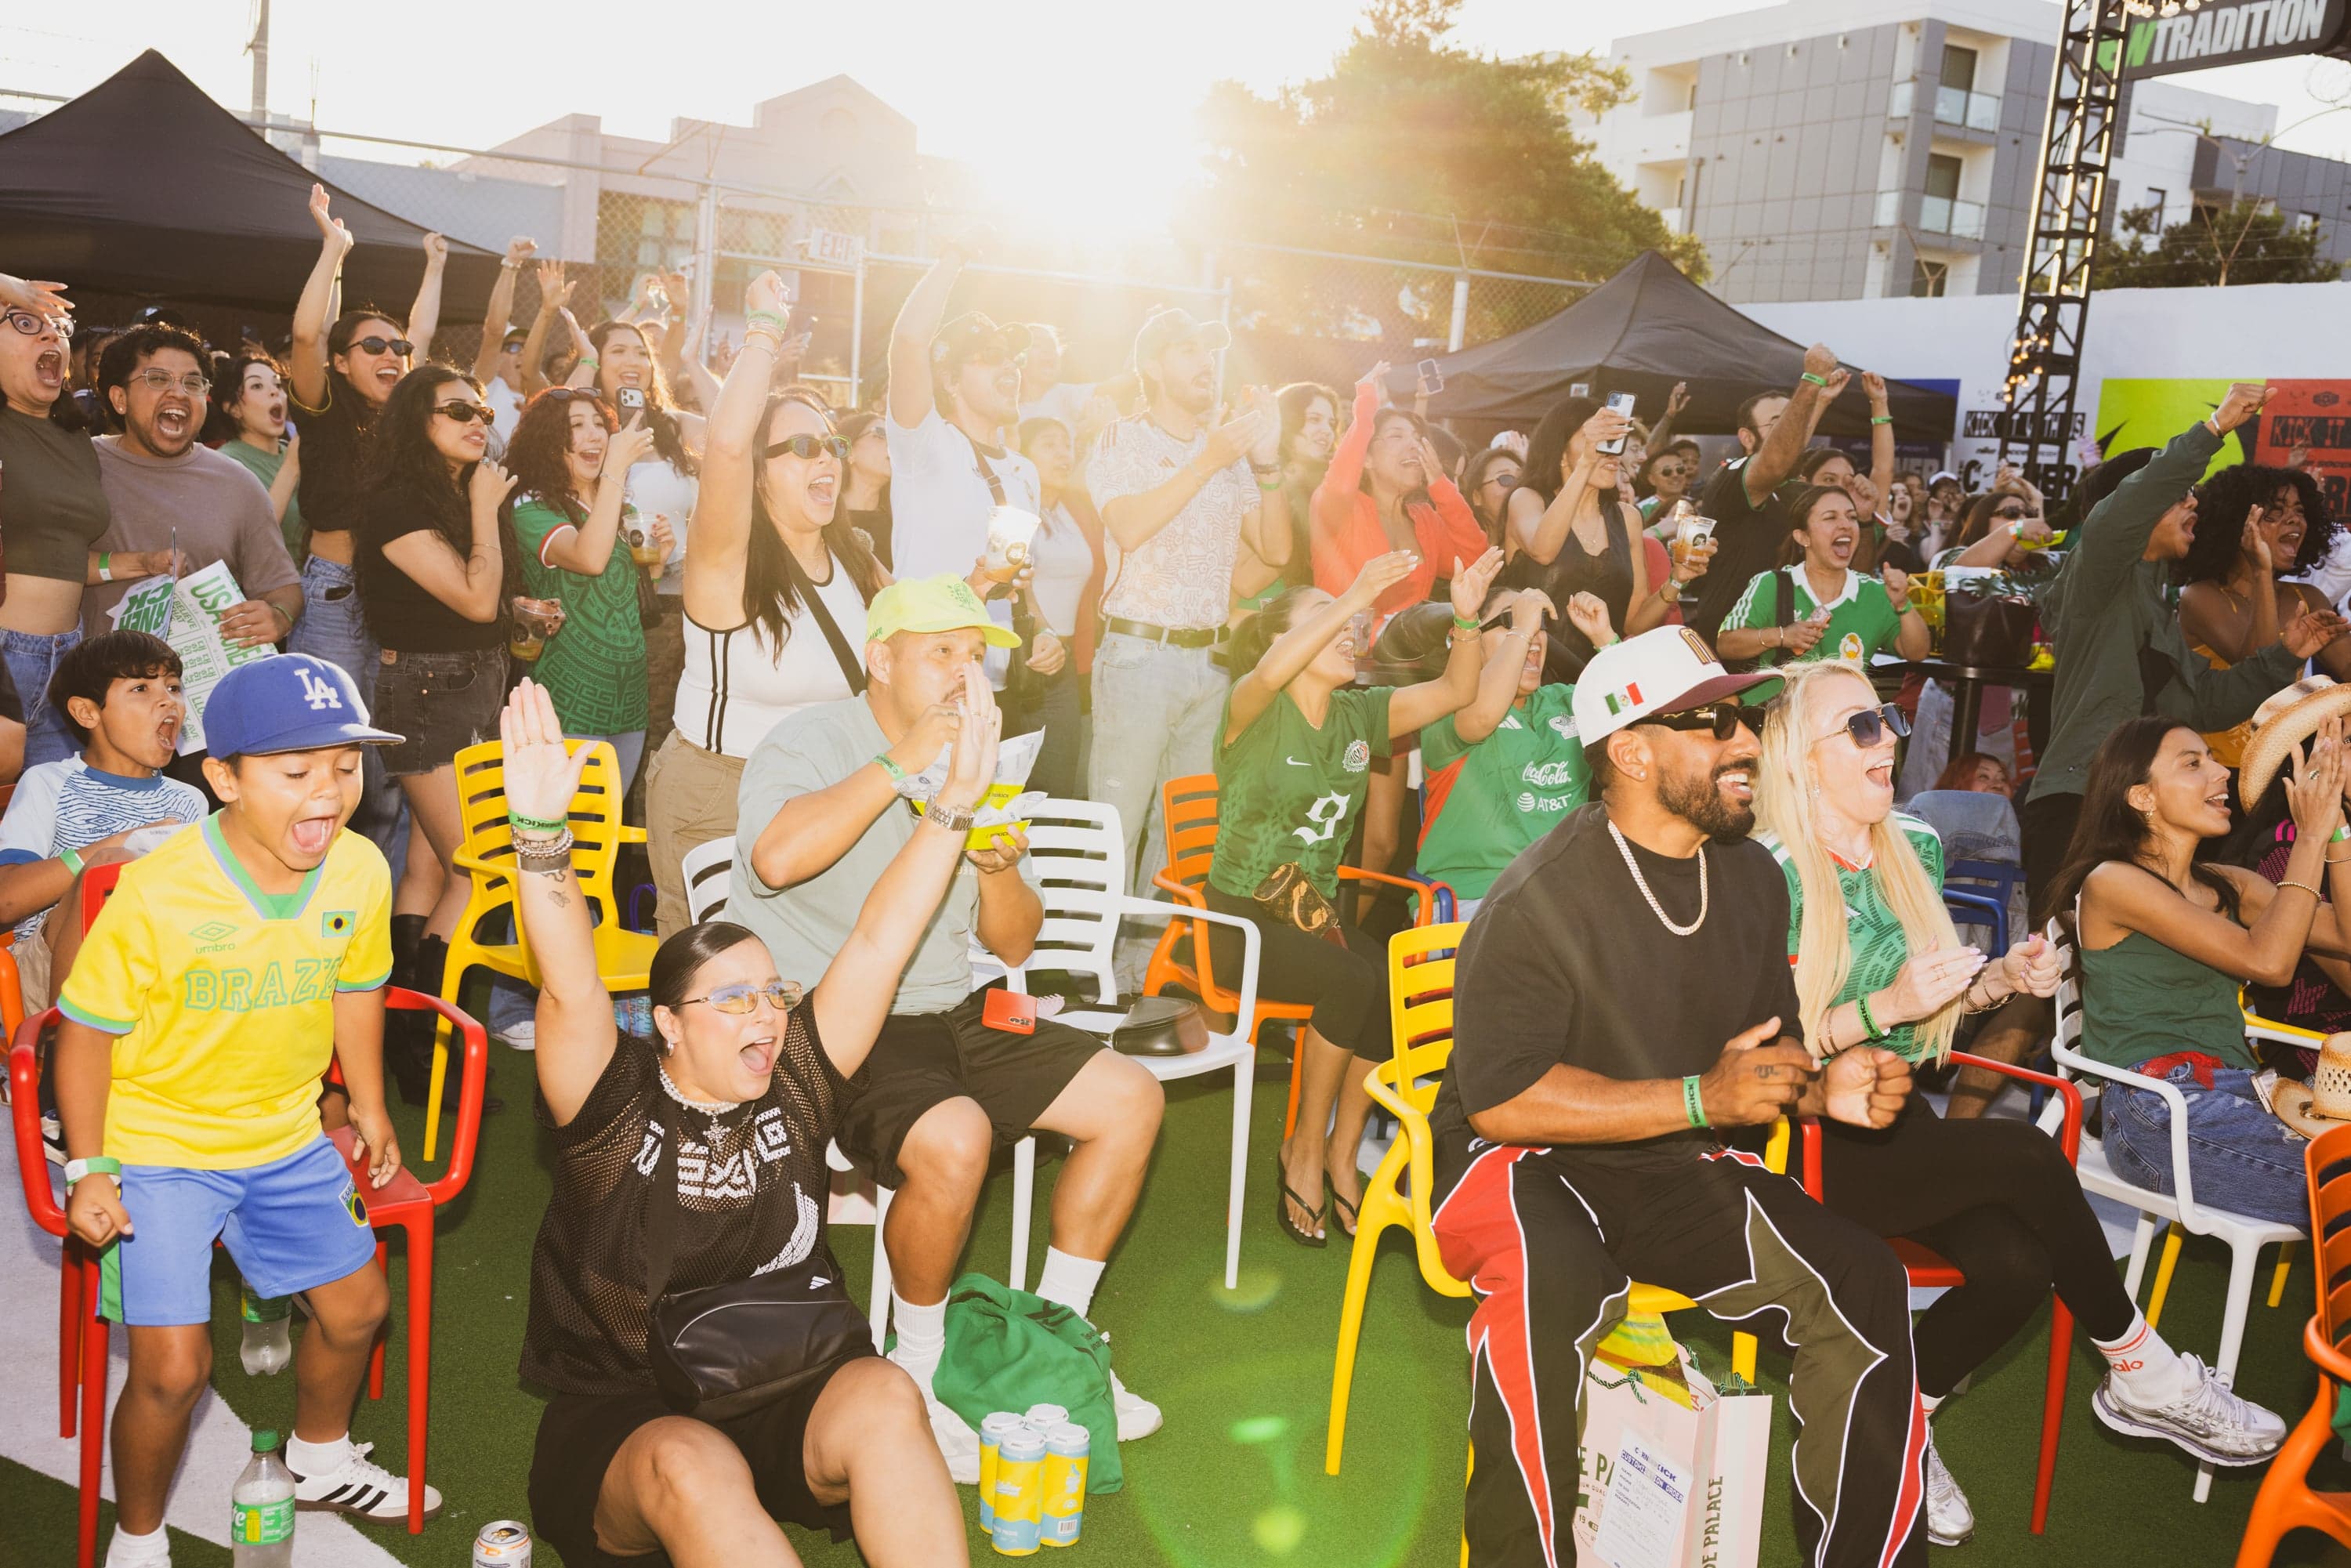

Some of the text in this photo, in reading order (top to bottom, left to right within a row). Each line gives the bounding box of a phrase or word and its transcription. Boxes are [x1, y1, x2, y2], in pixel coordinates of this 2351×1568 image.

[2152, 0, 2328, 64] TRADITION
[1965, 412, 1998, 436] KICK
[2274, 418, 2346, 447] KICK IT
[175, 600, 197, 629] BELIEVE
[190, 576, 233, 625] USA
[294, 668, 342, 710] LA
[1537, 795, 1569, 812] AT&T
[195, 943, 236, 954] umbro
[2113, 1359, 2143, 1372] alo
[1703, 1476, 1723, 1549] PALACE
